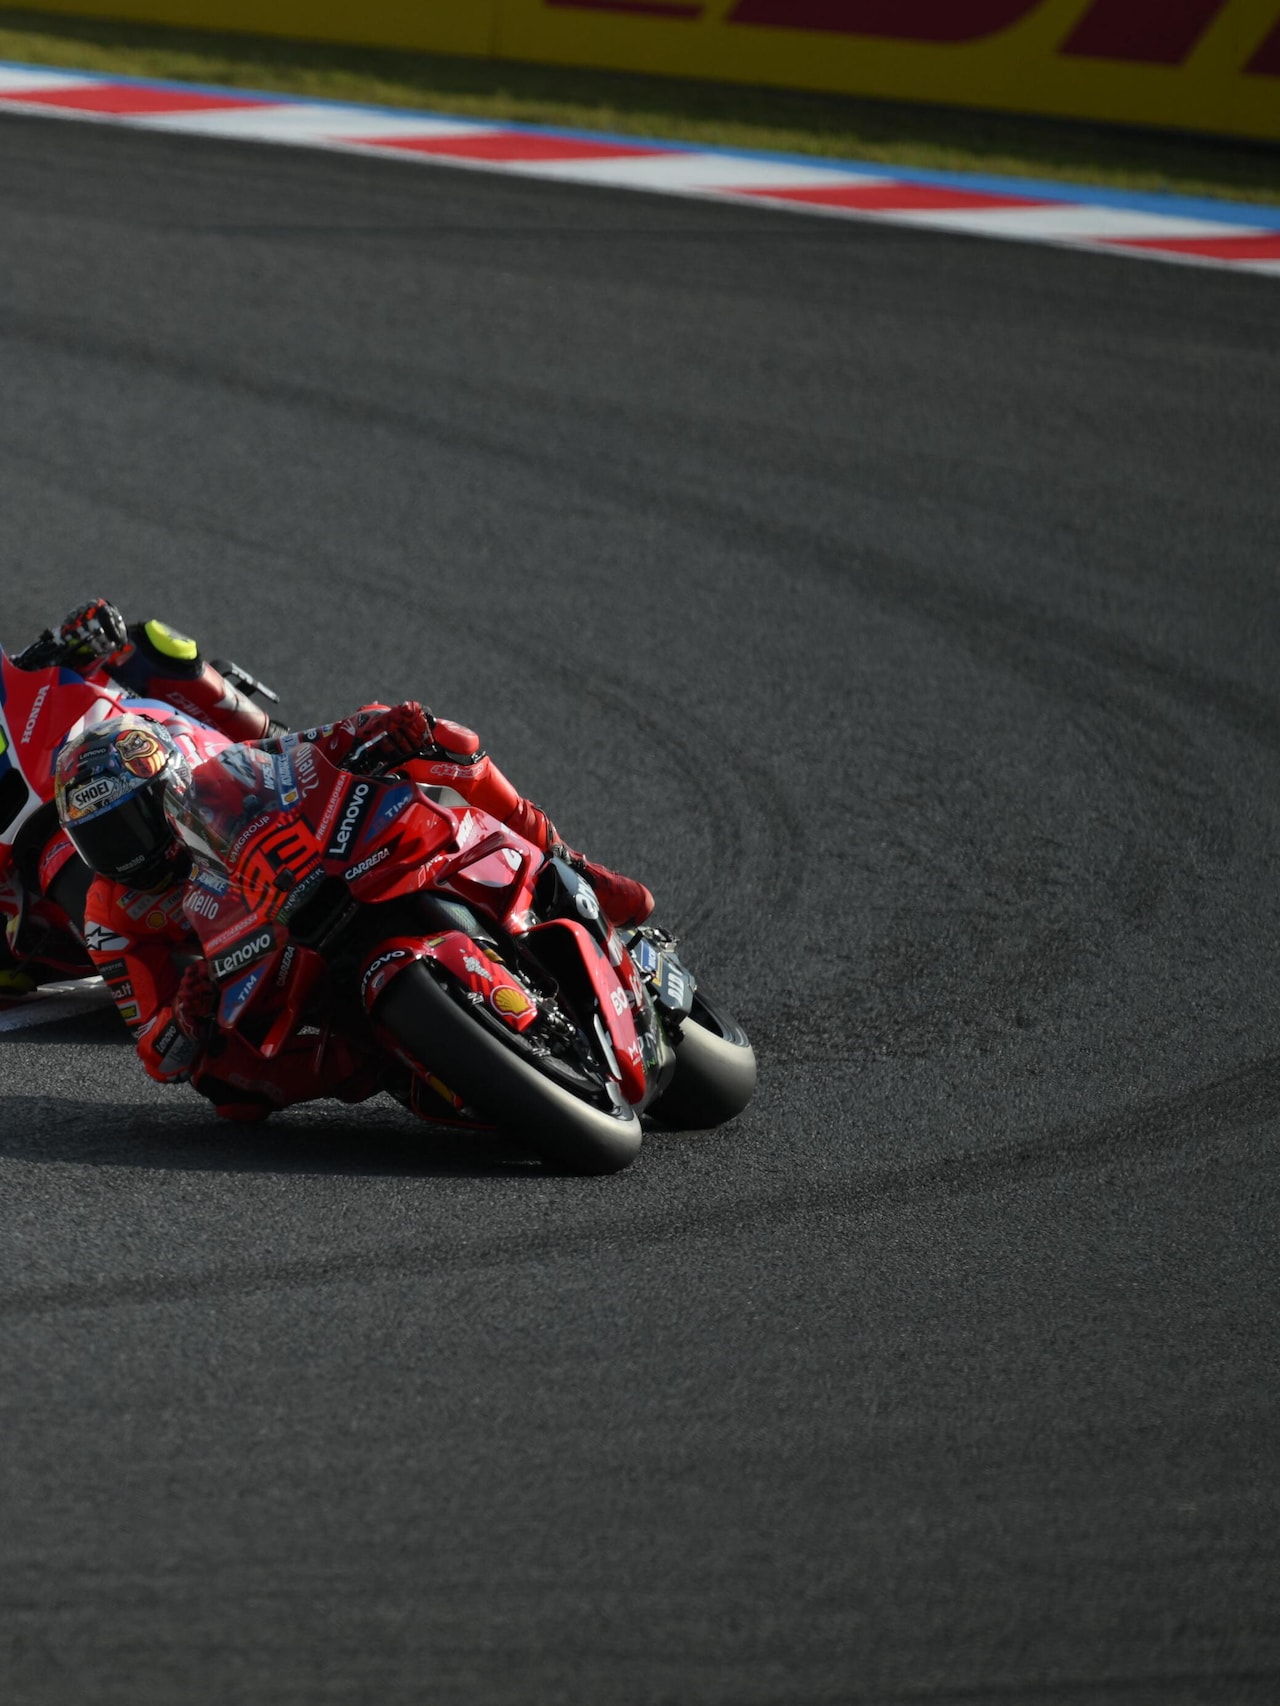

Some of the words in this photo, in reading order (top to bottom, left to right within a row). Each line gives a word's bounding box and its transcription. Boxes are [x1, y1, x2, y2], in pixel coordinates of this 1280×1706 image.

[21, 685, 51, 744] HONDA
[80, 748, 107, 760] Lenovo
[75, 782, 109, 806] SHOEI
[385, 795, 410, 818] TIM
[329, 783, 370, 854] Lenovo
[242, 819, 321, 913] 93
[344, 847, 390, 880] CARRERA
[214, 933, 271, 977] Lenovo
[237, 974, 258, 1001] TIM
